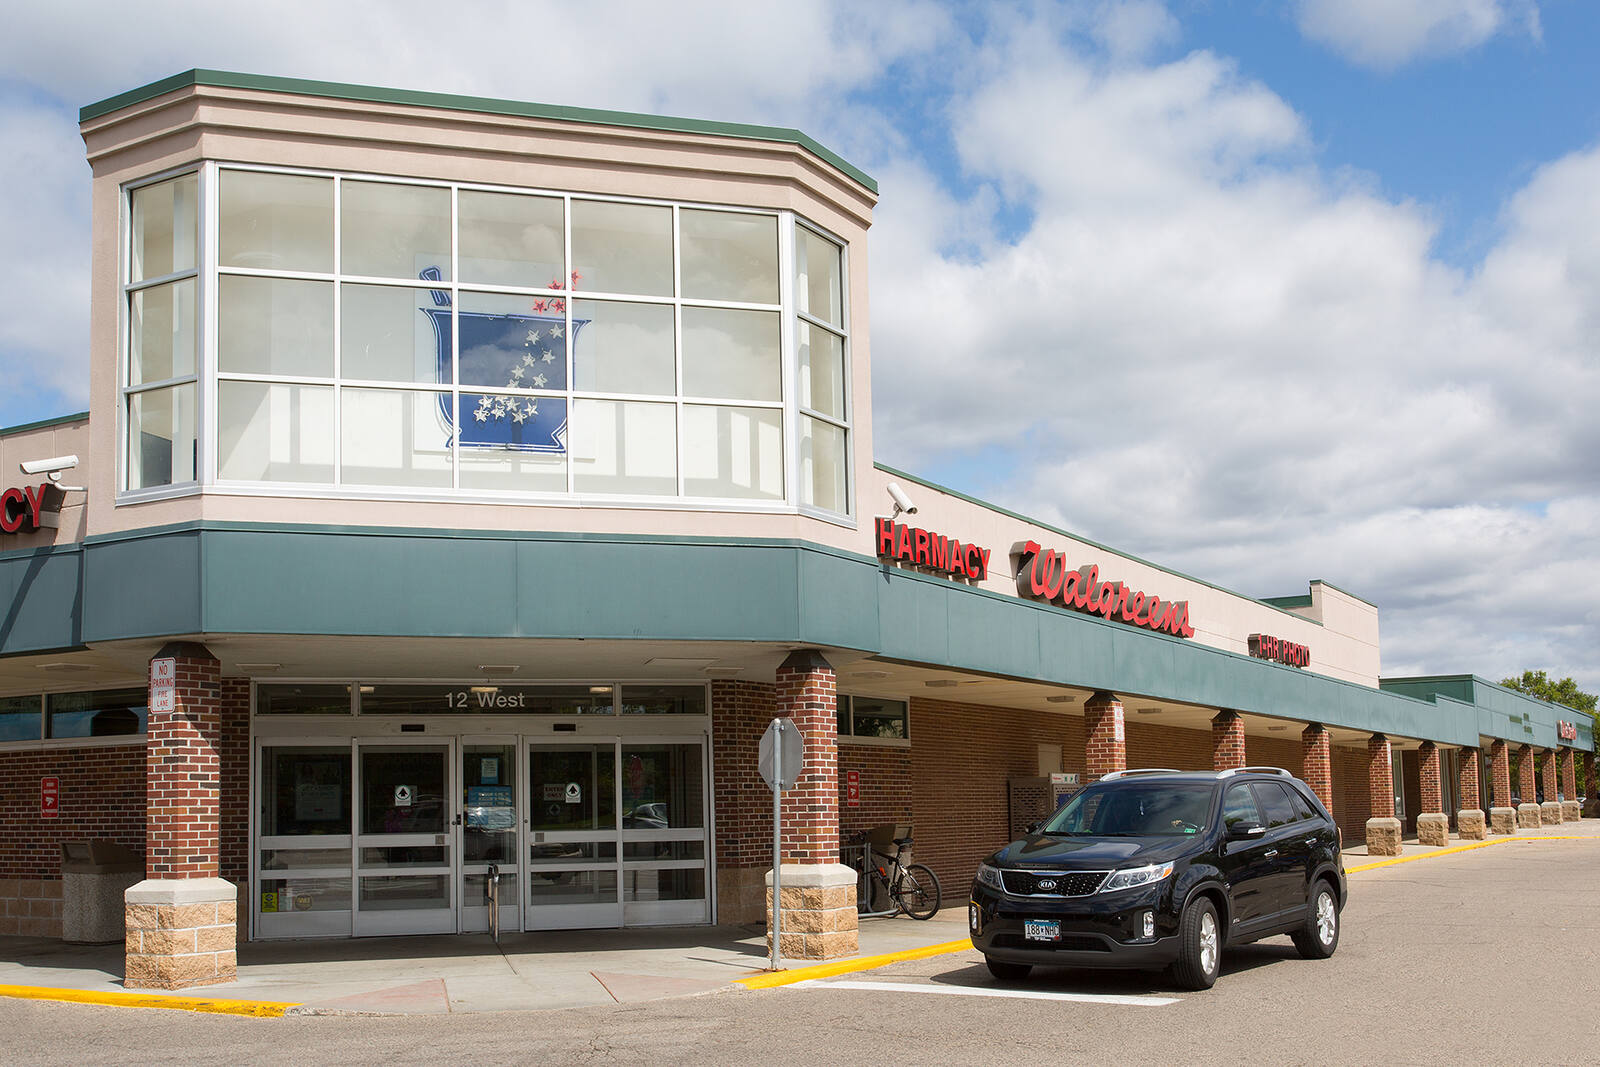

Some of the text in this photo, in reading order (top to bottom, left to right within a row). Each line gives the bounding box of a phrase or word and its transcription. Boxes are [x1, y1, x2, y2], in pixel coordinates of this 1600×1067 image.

[875, 517, 991, 581] HARMACY
[1024, 540, 1195, 638] Walgreens
[158, 664, 168, 676] NO
[153, 677, 174, 688] PARKING
[157, 690, 168, 698] FIRE
[445, 692, 525, 708] 12 West
[157, 699, 169, 707] LANE
